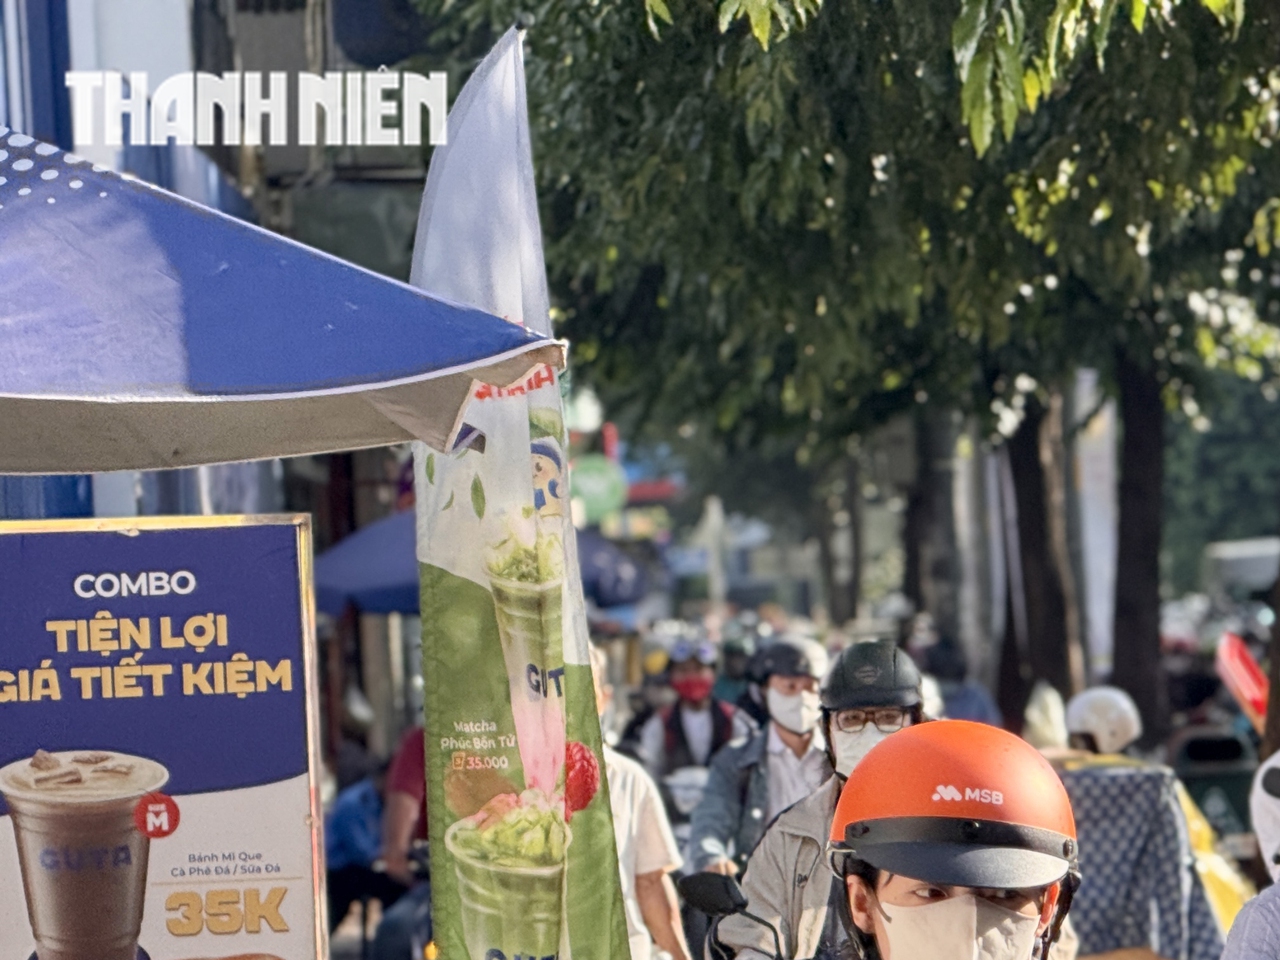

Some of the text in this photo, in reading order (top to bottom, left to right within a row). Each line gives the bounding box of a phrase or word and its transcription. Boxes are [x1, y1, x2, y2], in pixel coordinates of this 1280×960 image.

[74, 570, 196, 598] COMBO
[46, 610, 228, 656] TIỆN LỢI
[71, 652, 172, 699] TIẾT
[182, 652, 292, 698] KIỆM
[526, 663, 565, 698] GUT
[453, 720, 497, 732] Matcha
[466, 755, 509, 769] 35.000
[965, 787, 1003, 805] MSB
[147, 811, 169, 831] M
[39, 844, 133, 872] GUTA
[238, 851, 262, 862] Que
[165, 887, 289, 937] 35K
